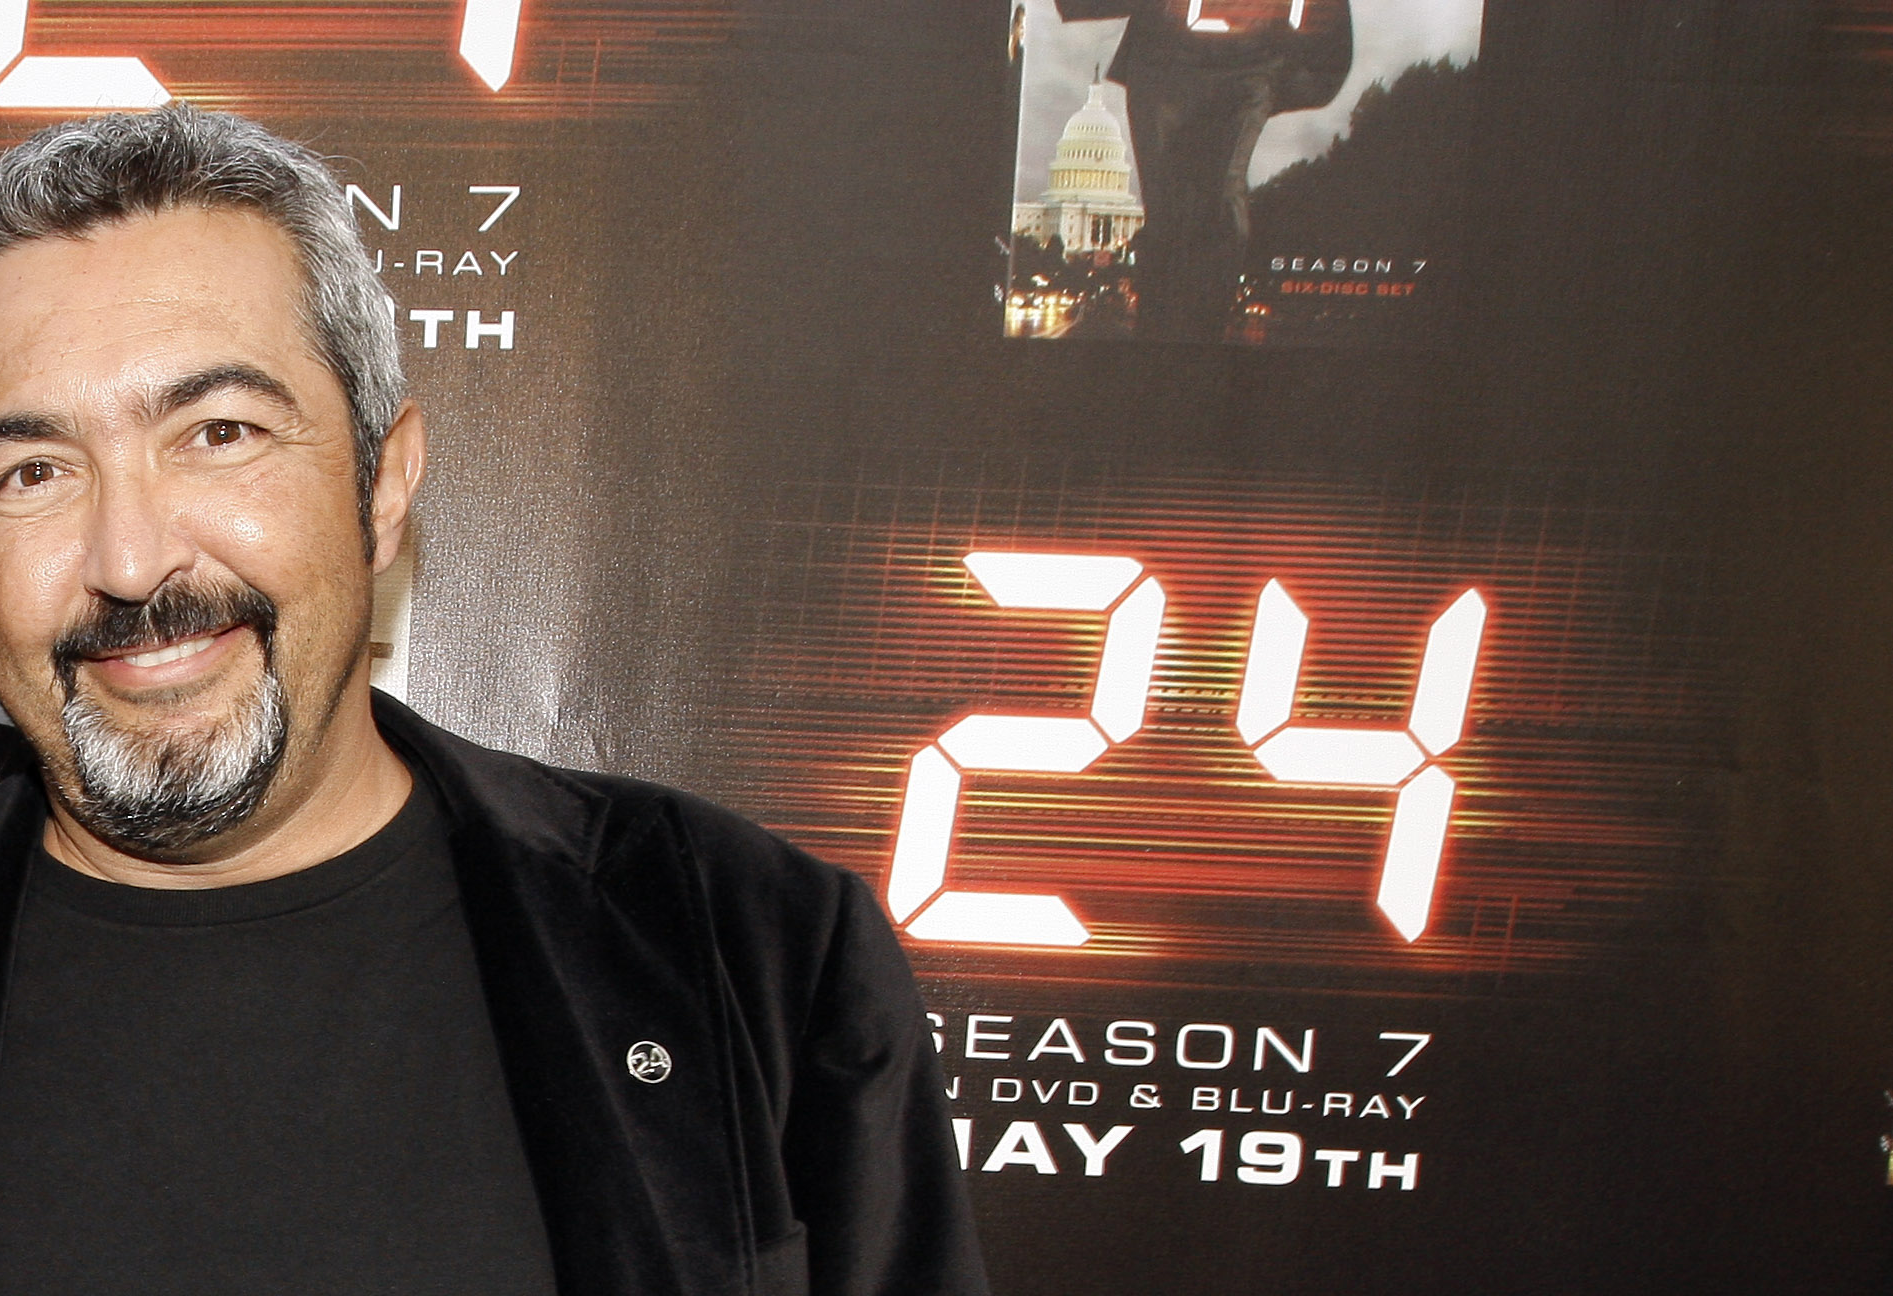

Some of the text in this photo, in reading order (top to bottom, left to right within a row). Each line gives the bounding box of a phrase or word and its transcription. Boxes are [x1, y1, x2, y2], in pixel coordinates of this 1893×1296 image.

[468, 185, 521, 232] 7
[1271, 257, 1426, 274] SEASON 7
[886, 550, 1488, 949] 24
[1379, 1032, 1431, 1077] 7
[991, 1078, 1099, 1106] DVD
[1129, 1084, 1163, 1109] &
[1191, 1086, 1426, 1120] BLU-RAY
[1179, 1129, 1419, 1191] 19TH
